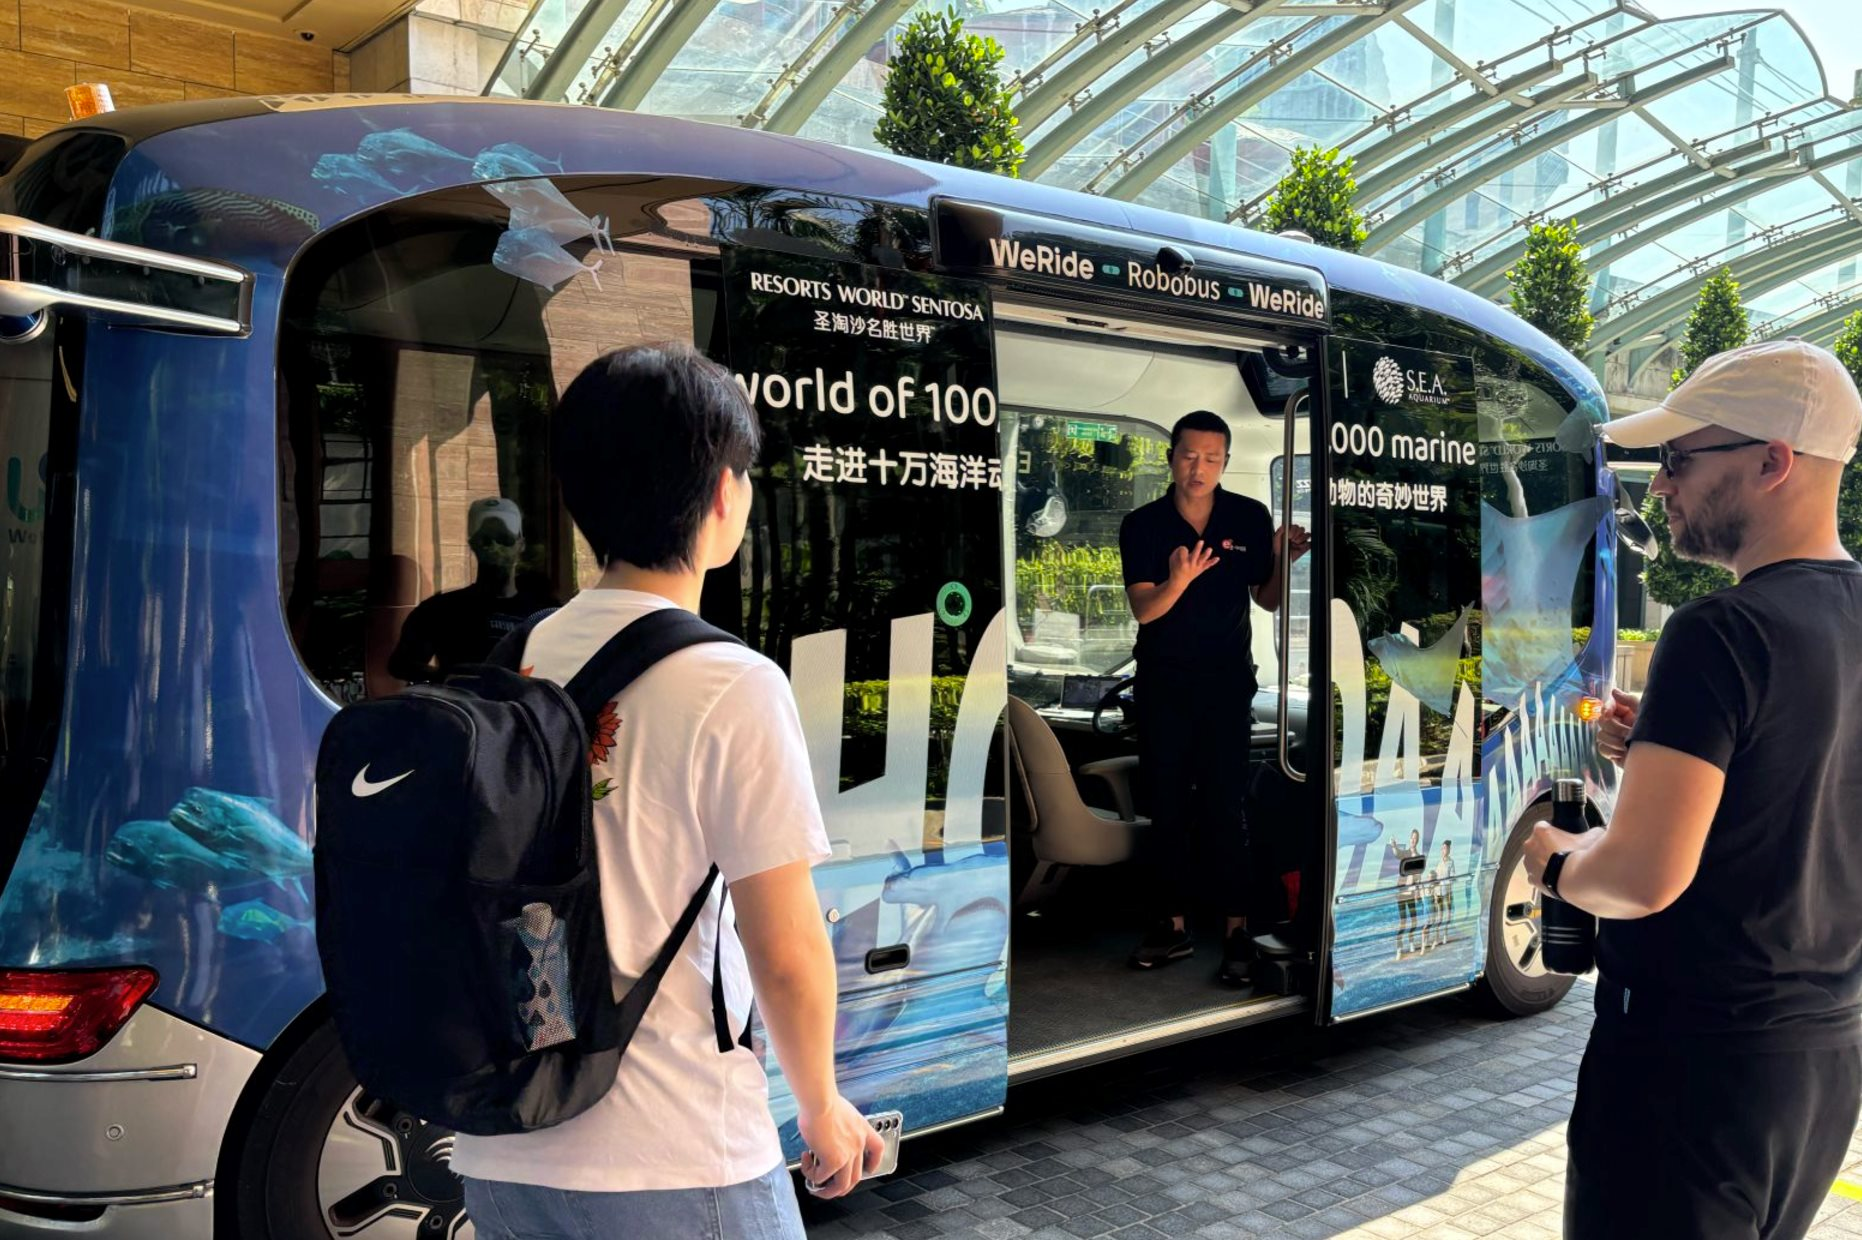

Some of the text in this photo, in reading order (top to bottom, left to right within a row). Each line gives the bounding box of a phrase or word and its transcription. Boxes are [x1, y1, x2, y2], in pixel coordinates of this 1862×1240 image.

[750, 271, 831, 300] RESORTS
[911, 295, 984, 322] SENTOSA
[989, 238, 1326, 320] WeRide Robobus WeRide
[813, 310, 932, 344] 圣淘沙名胜世界
[868, 376, 915, 419] of
[1406, 369, 1448, 396] S.E.A.
[1408, 393, 1449, 405] AQUARIUM
[1391, 430, 1476, 466] marine
